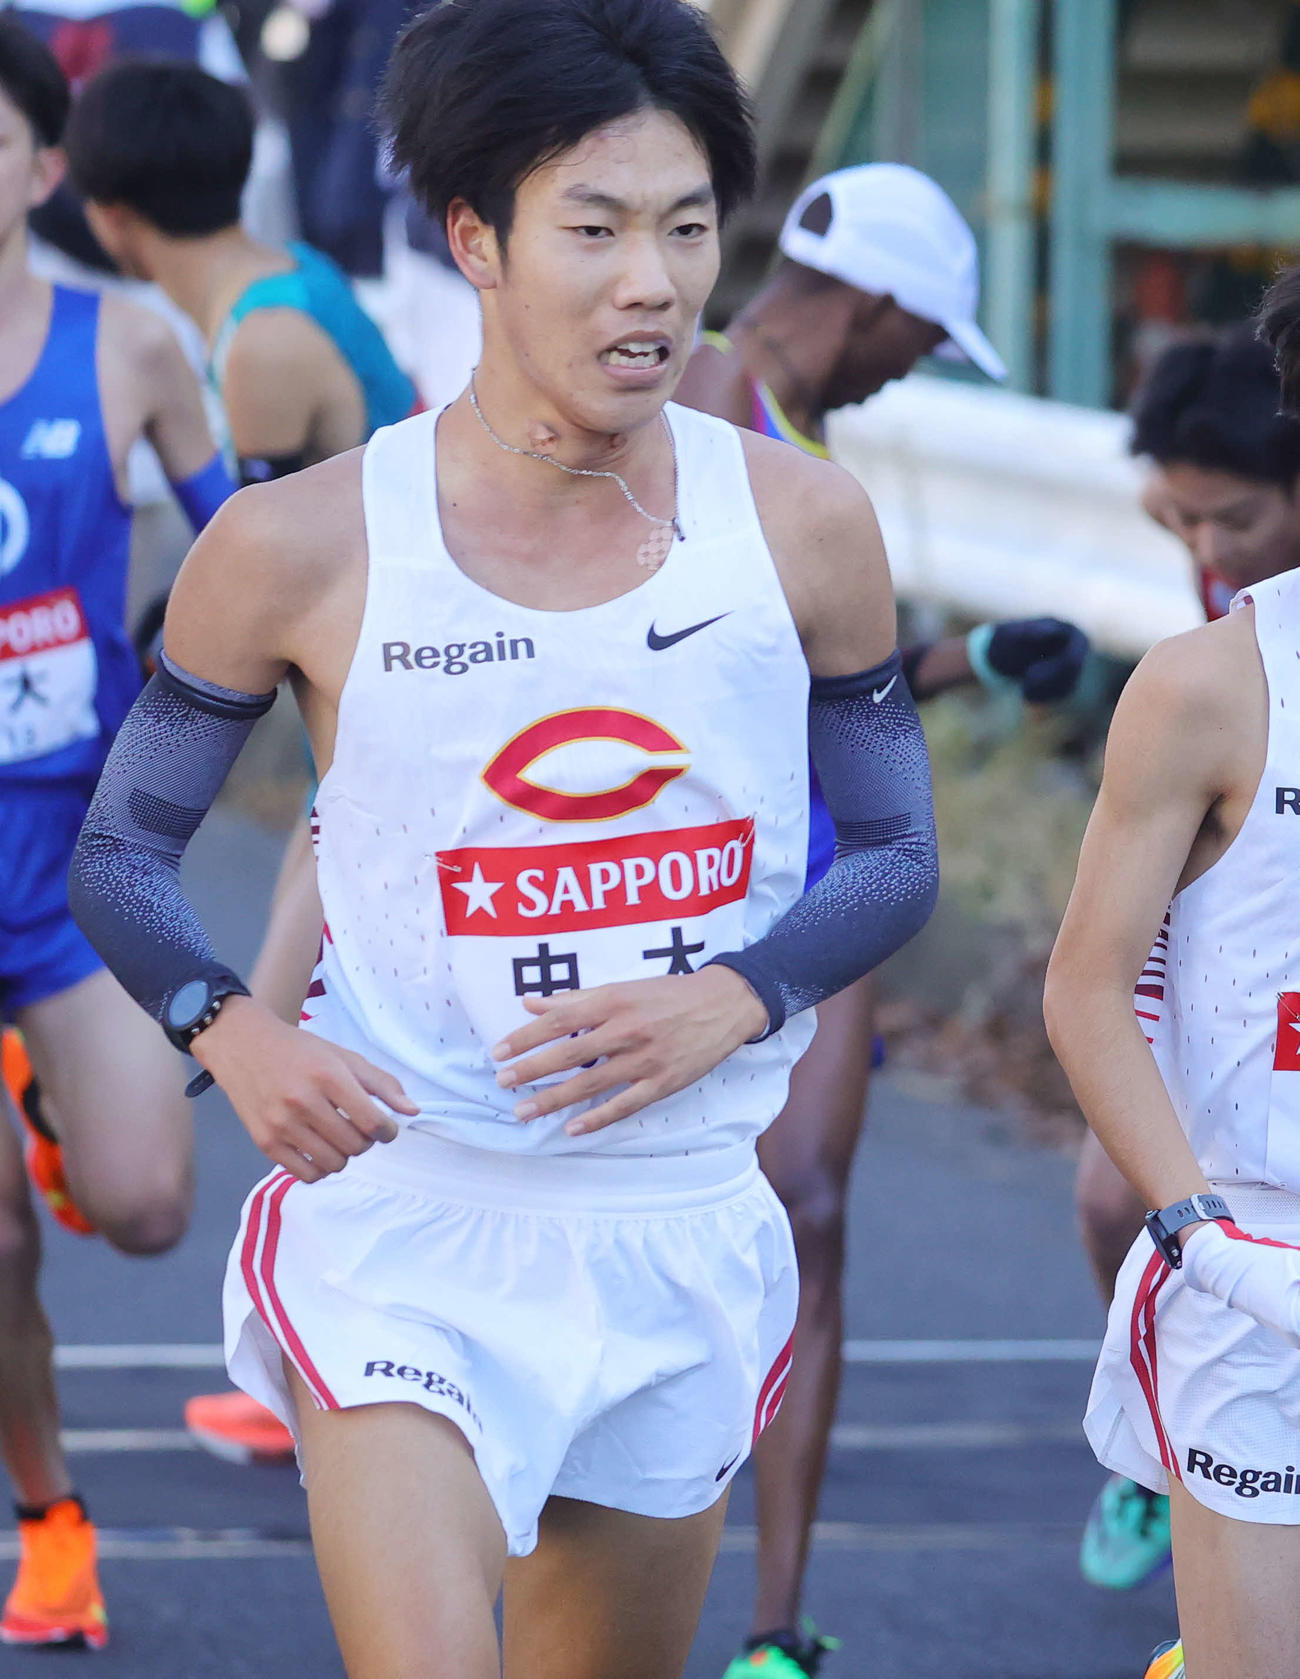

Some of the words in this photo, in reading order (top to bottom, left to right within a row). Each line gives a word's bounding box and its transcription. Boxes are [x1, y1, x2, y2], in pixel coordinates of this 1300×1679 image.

[382, 631, 535, 676] Regain
[515, 839, 744, 918] SAPPORO
[1186, 1447, 1300, 1498] Regai
